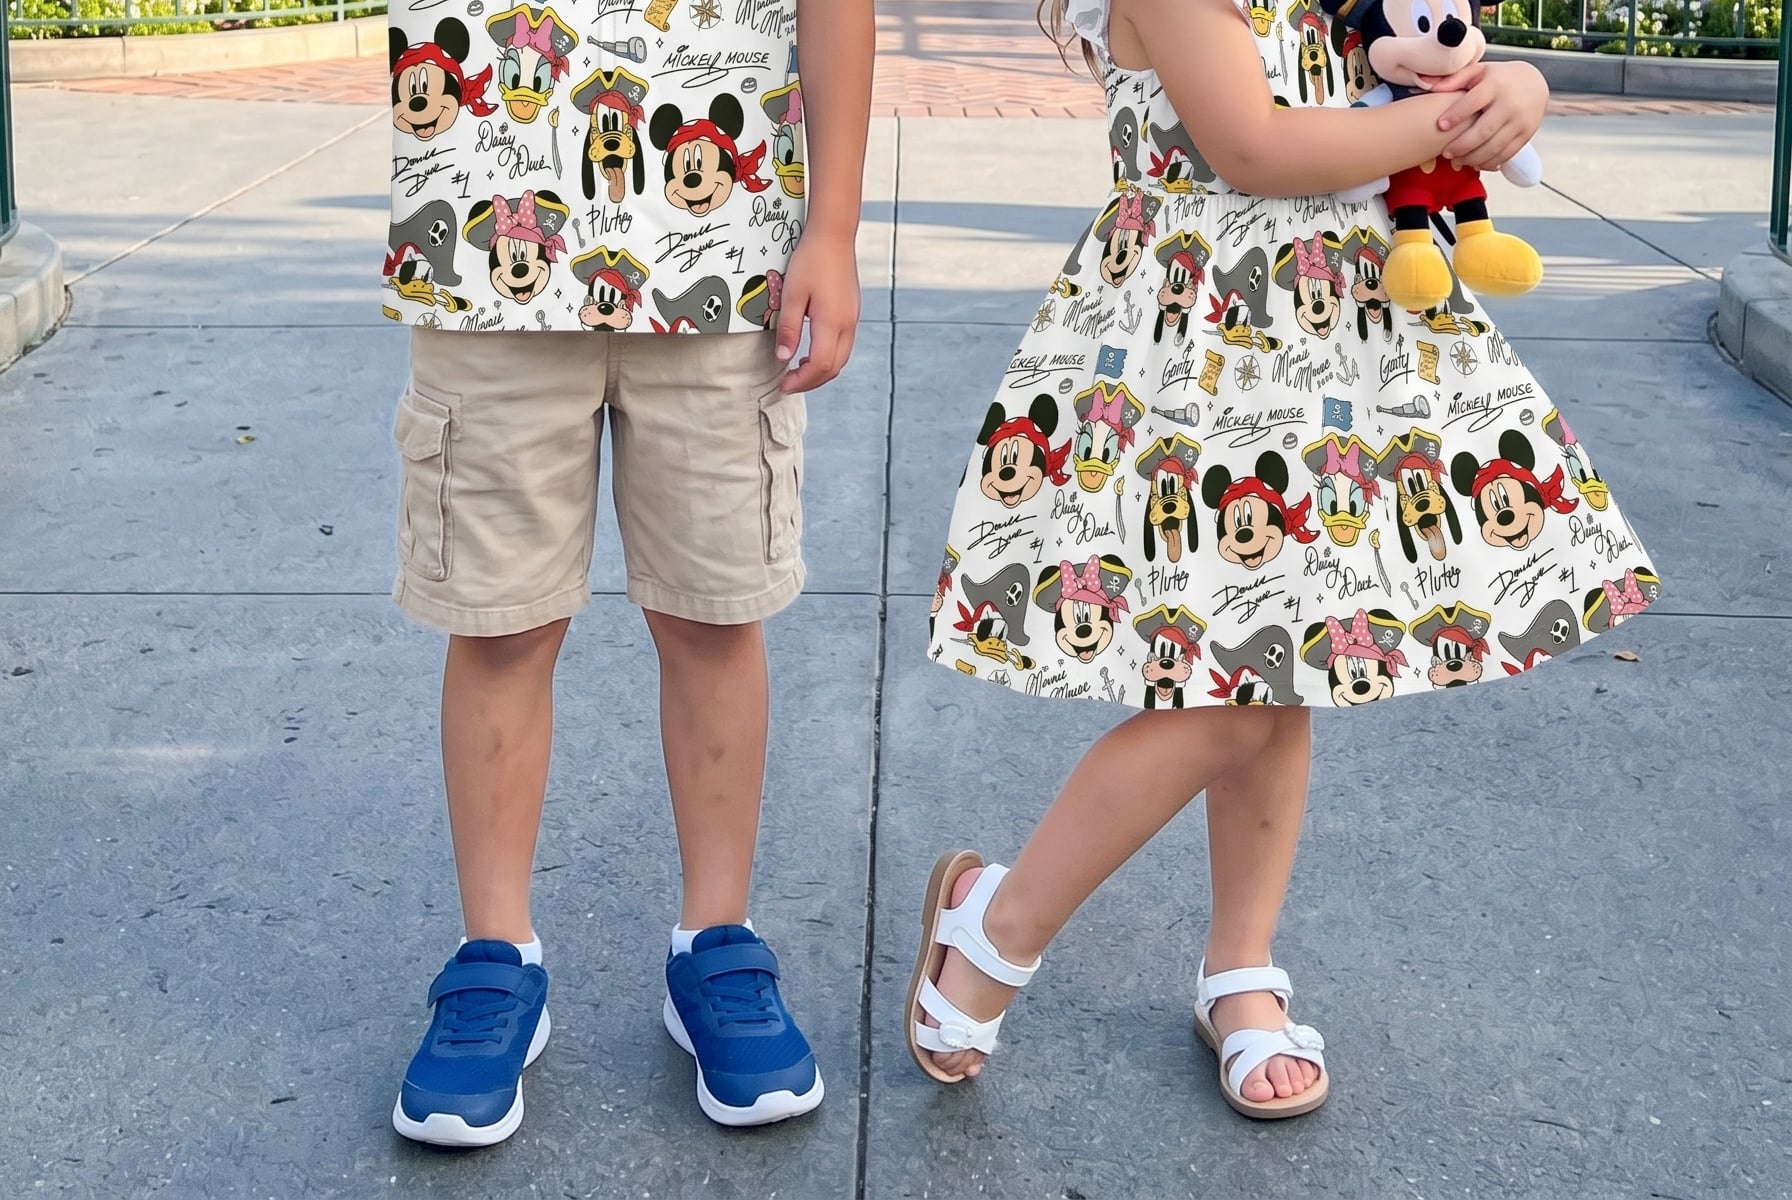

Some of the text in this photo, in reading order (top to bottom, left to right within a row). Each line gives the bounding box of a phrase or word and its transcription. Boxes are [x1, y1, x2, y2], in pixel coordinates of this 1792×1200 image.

[725, 51, 770, 65] MOUSE
[1132, 81, 1146, 104] #1
[451, 171, 471, 198] #1
[1264, 217, 1278, 244] #1
[725, 246, 745, 274] #1
[1497, 383, 1533, 398] MOUSE
[1266, 407, 1305, 421] MOUSE
[1029, 537, 1045, 564] #1
[1558, 566, 1580, 594] #1
[1284, 596, 1303, 623] #1
